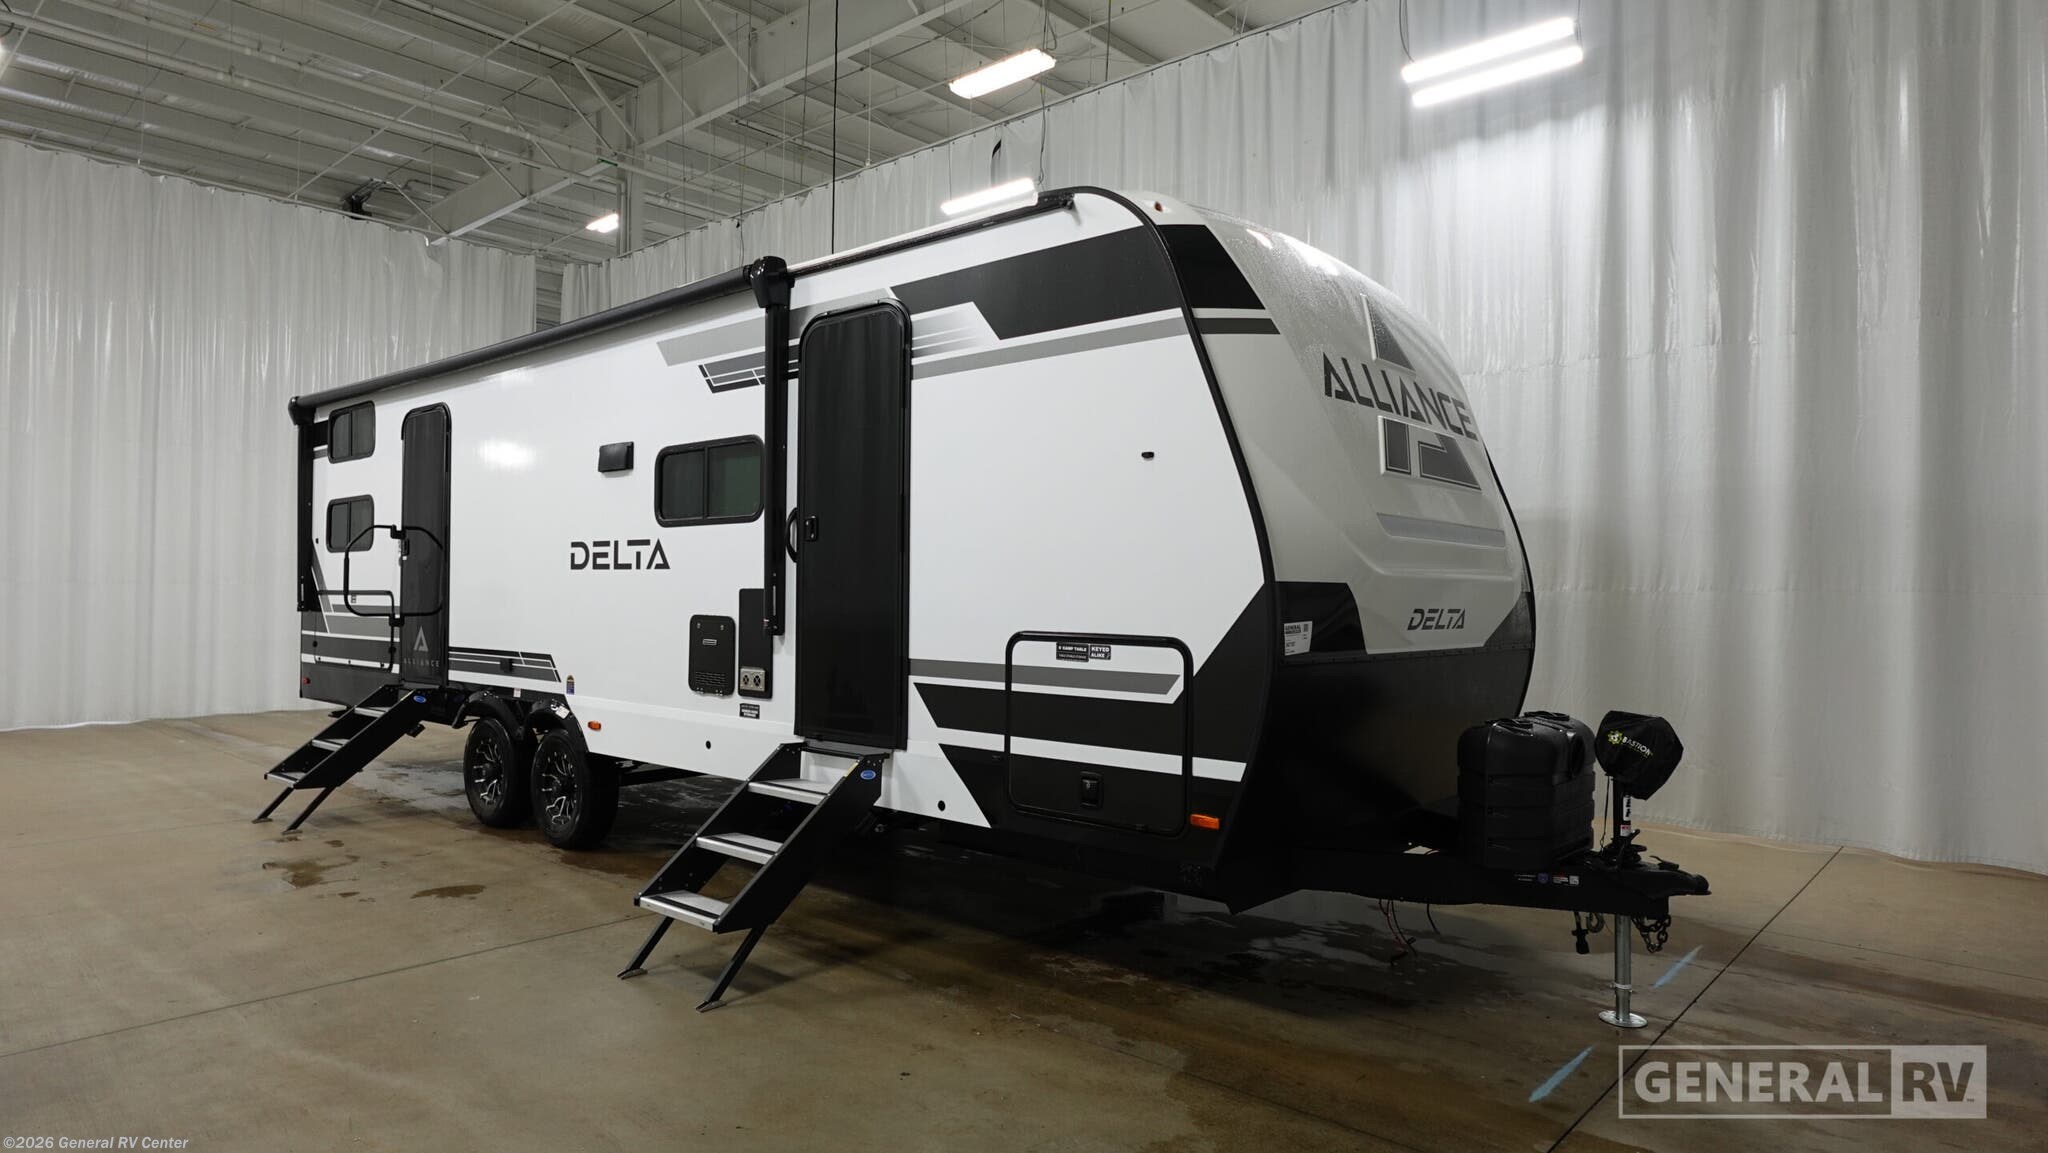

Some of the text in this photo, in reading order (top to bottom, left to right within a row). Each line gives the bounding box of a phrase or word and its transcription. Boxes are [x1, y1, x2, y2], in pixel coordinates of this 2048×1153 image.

[1322, 351, 1479, 441] ALLIANCE
[570, 538, 671, 570] DELTA
[1407, 608, 1466, 631] DELTA
[403, 657, 440, 668] ALLIANCE
[1622, 736, 1651, 756] BASTION
